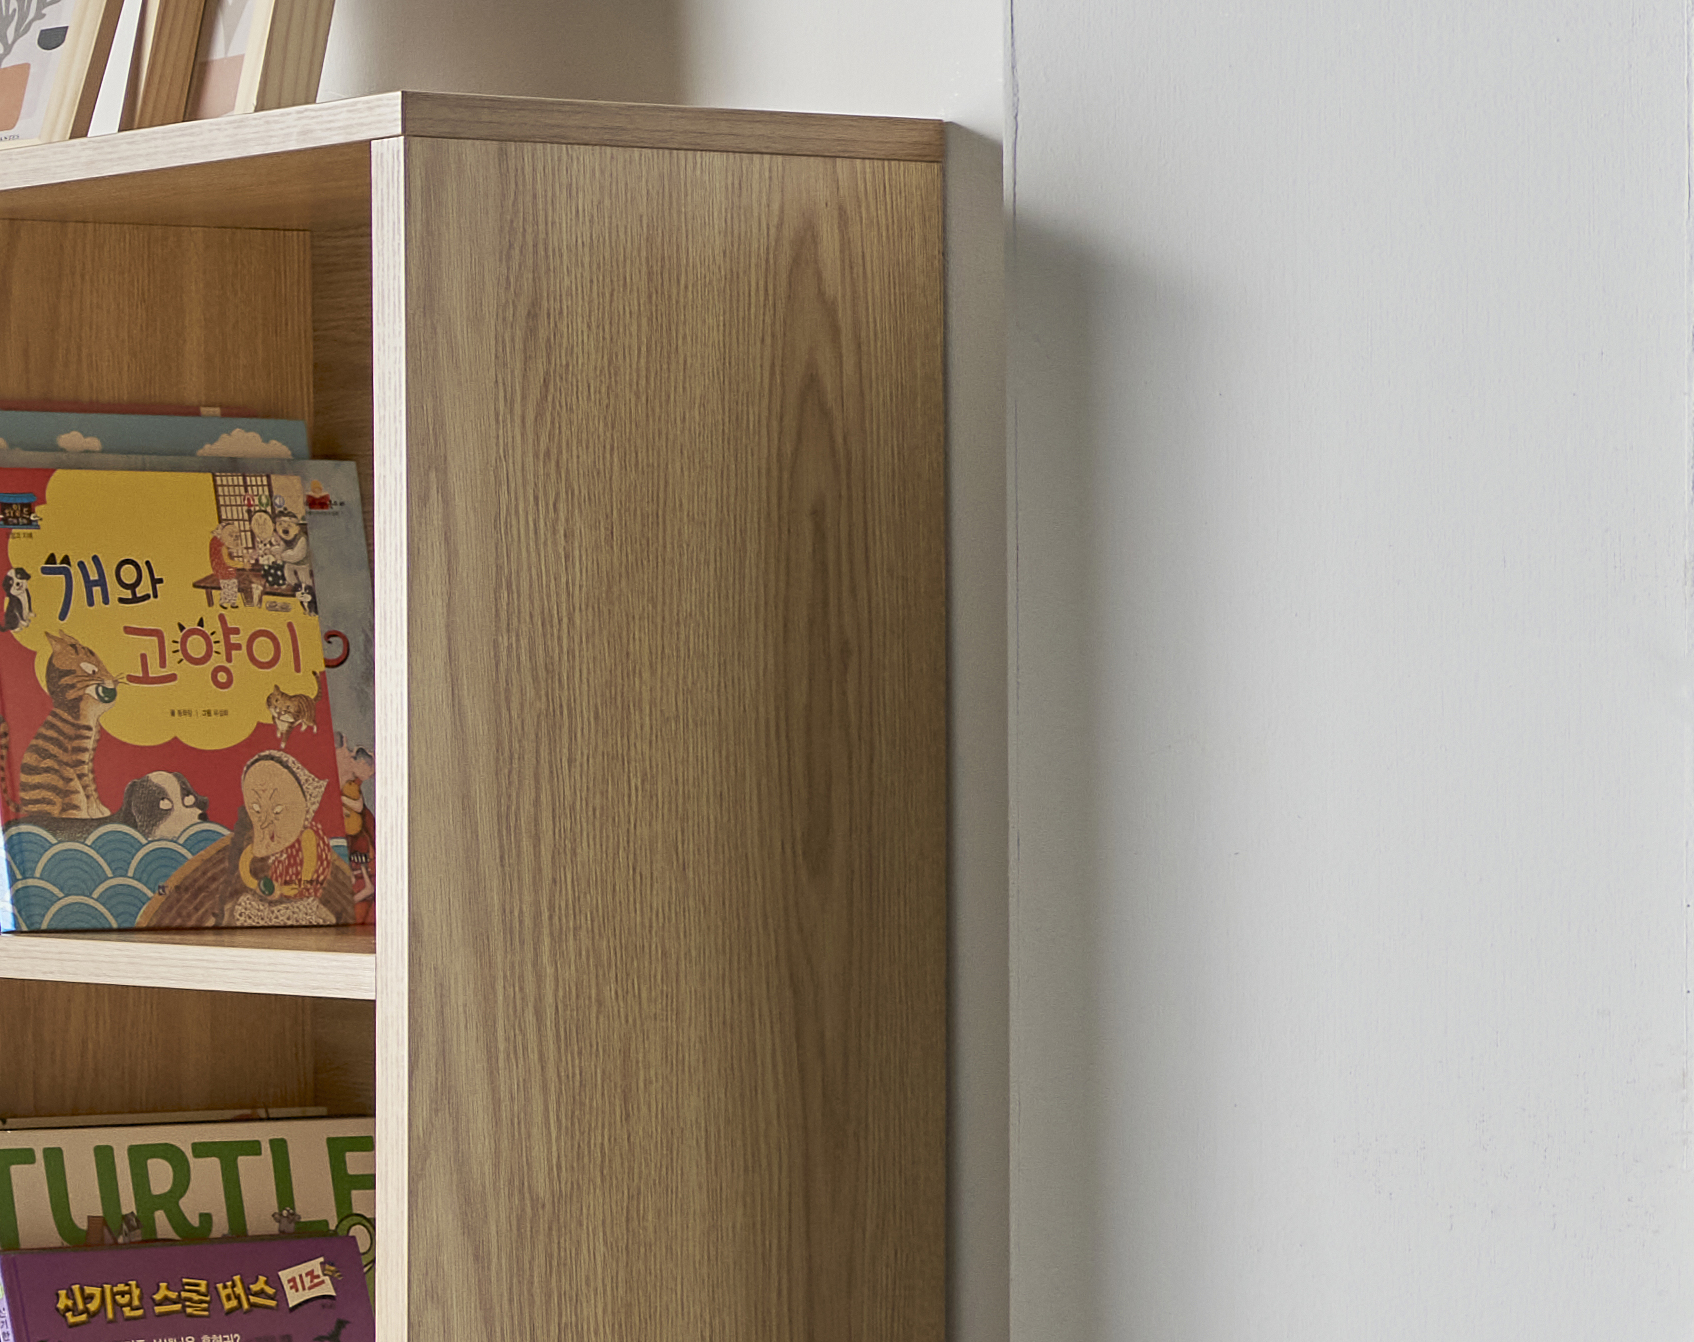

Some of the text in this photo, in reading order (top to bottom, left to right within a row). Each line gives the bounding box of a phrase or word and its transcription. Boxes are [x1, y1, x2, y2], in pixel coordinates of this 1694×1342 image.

[41, 553, 164, 622] 개와
[123, 613, 302, 690] 고양이
[56, 1269, 326, 1327] 신기한 스쿨 버스 키즈
